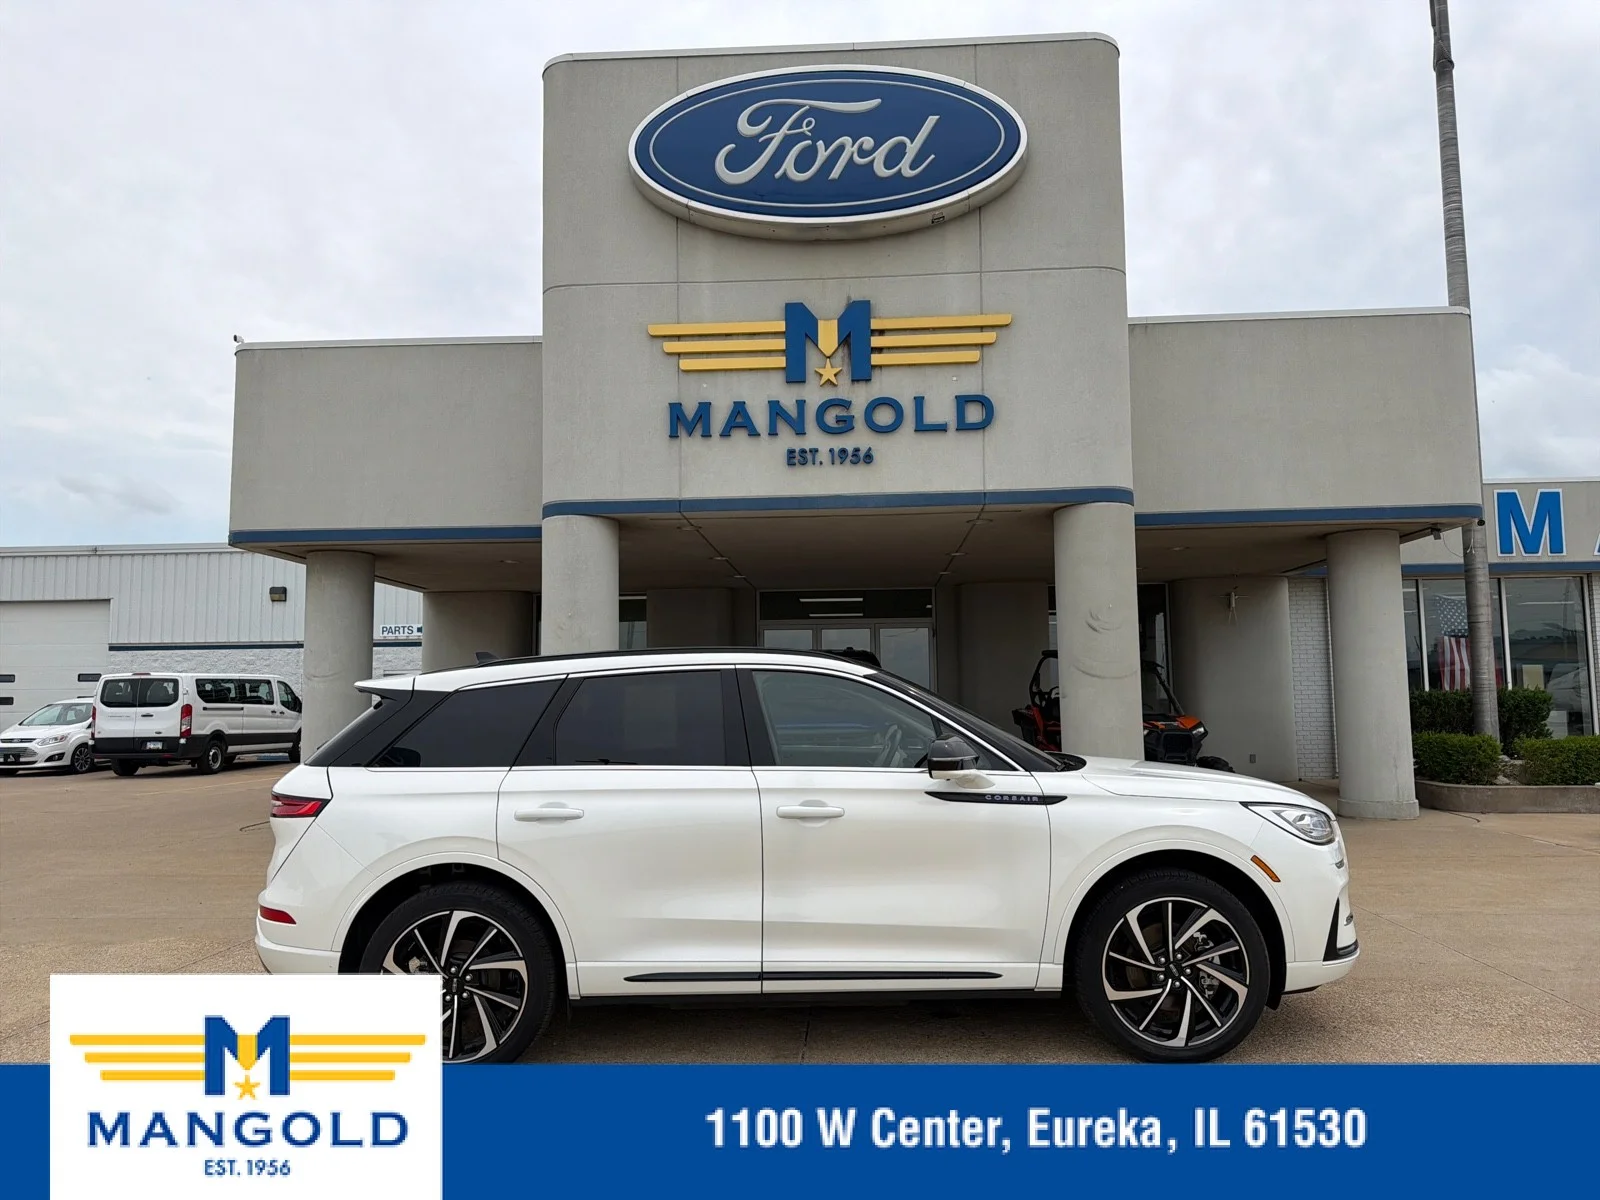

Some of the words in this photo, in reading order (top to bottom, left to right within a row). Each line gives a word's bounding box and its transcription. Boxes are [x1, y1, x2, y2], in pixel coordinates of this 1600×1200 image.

[714, 98, 942, 185] Ford
[668, 394, 996, 439] MANGOLD
[786, 447, 824, 466] EST.
[829, 446, 875, 466] 1956
[1494, 488, 1600, 557] M
[381, 625, 414, 636] PARTS
[985, 794, 1039, 802] CORSAIR
